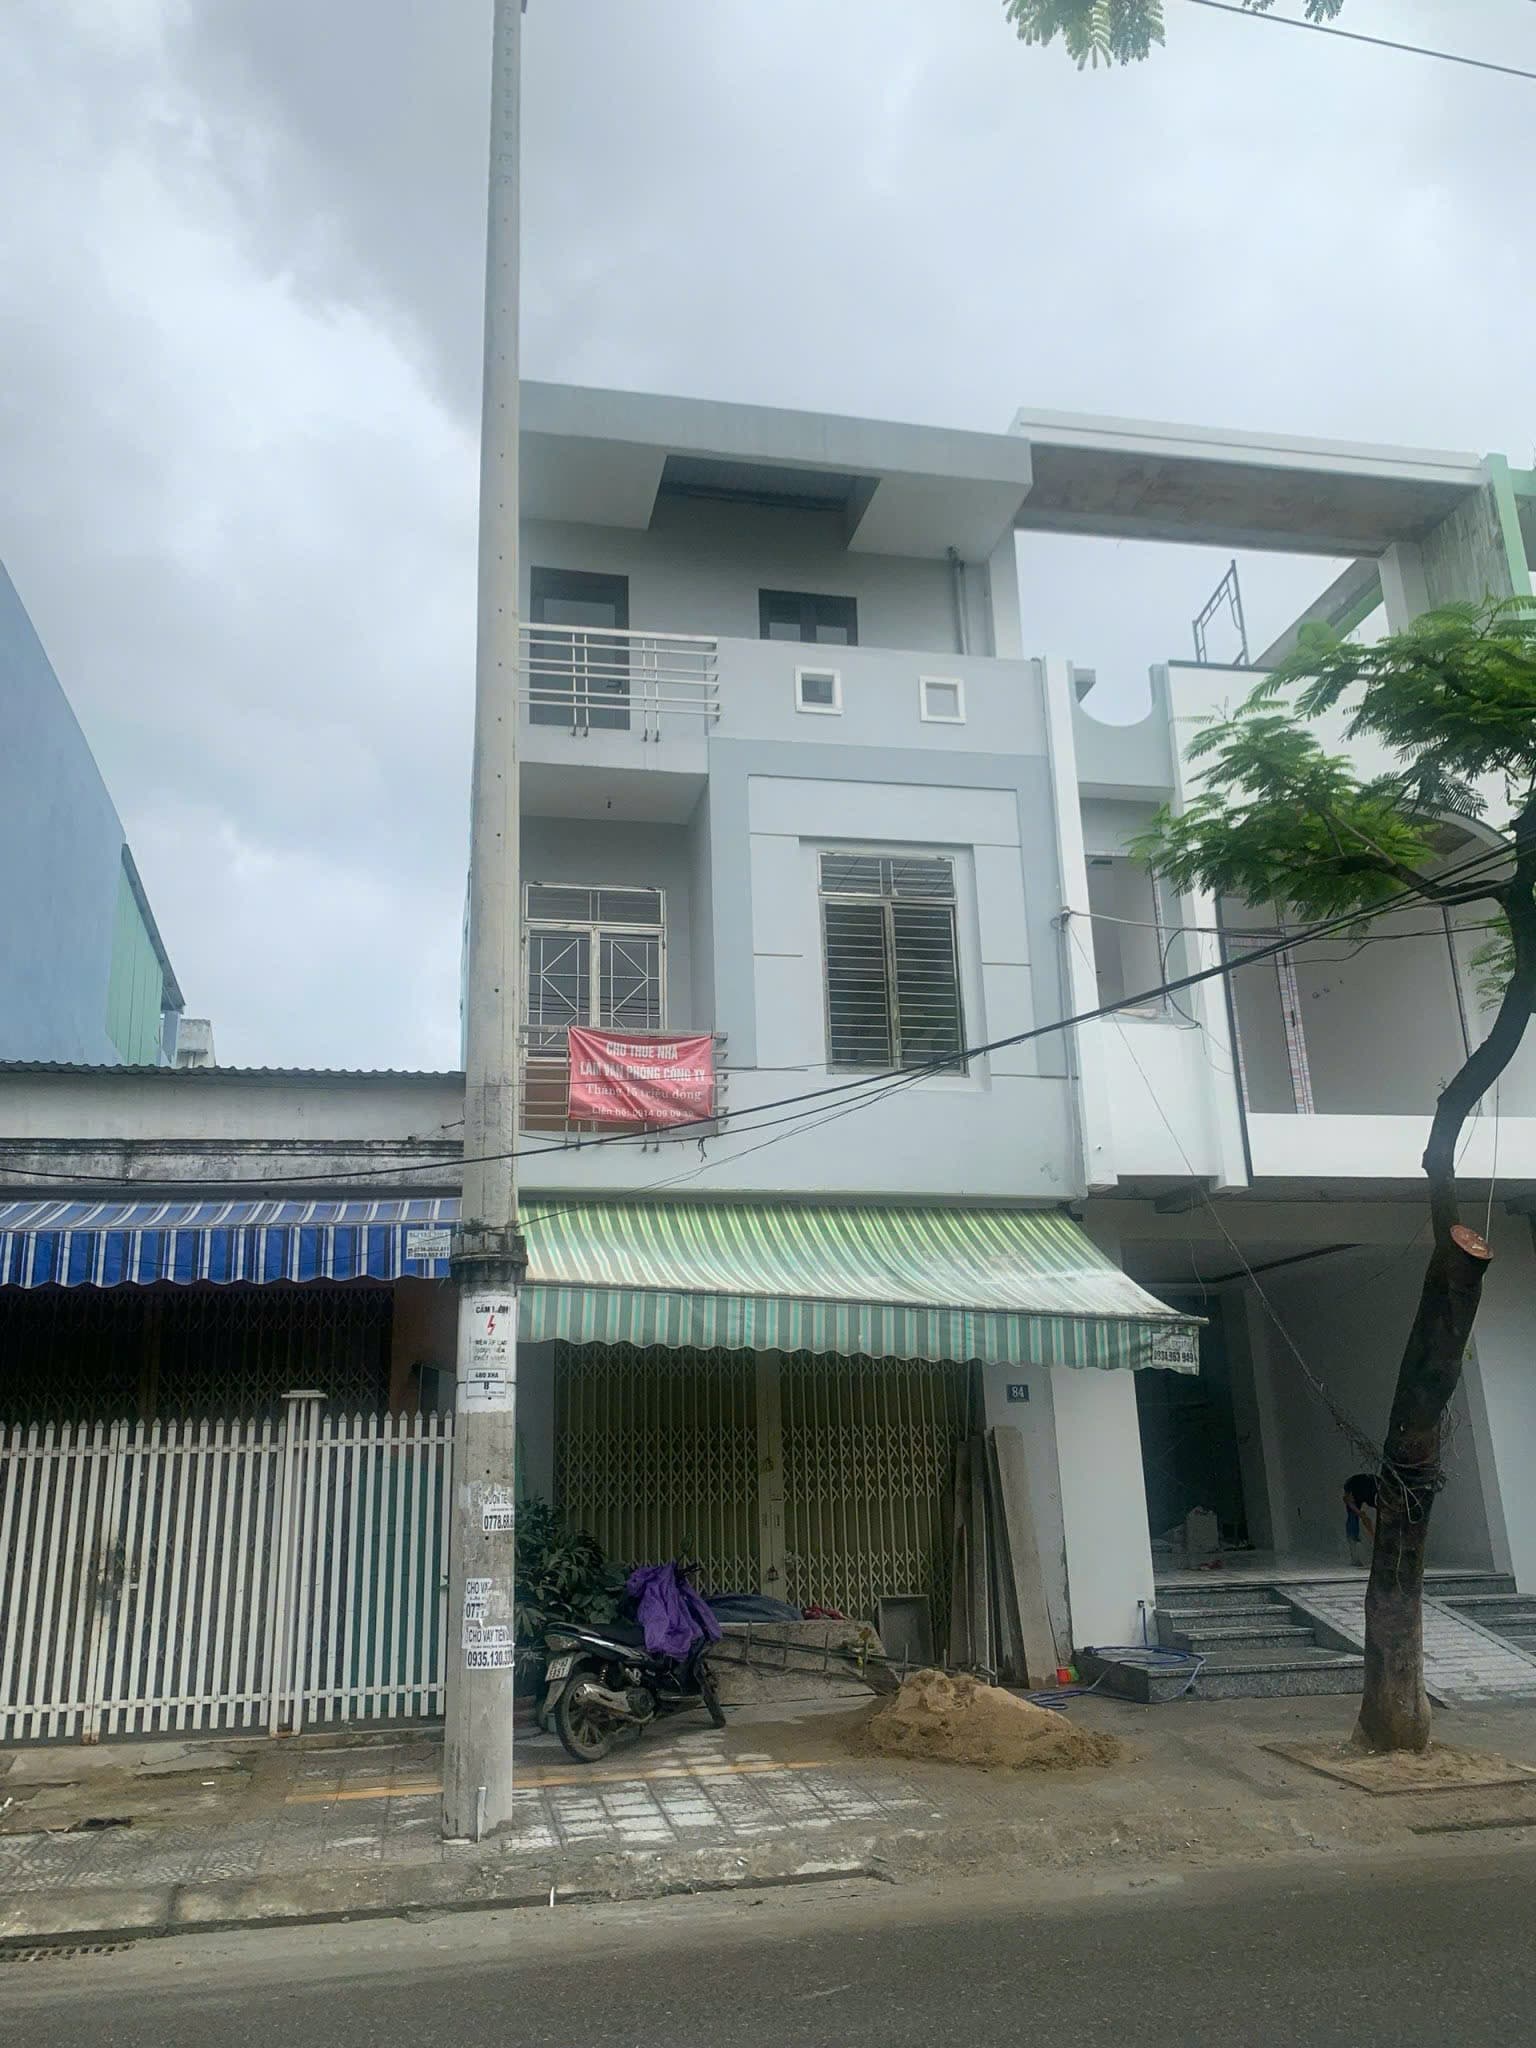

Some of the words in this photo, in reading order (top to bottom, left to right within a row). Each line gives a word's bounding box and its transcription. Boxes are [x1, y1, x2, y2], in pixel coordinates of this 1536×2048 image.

[606, 1041, 626, 1056] CHO
[1012, 1386, 1024, 1397] 84
[467, 1581, 480, 1594] CHO
[468, 1629, 482, 1642] CHO
[483, 1629, 494, 1642] VAY
